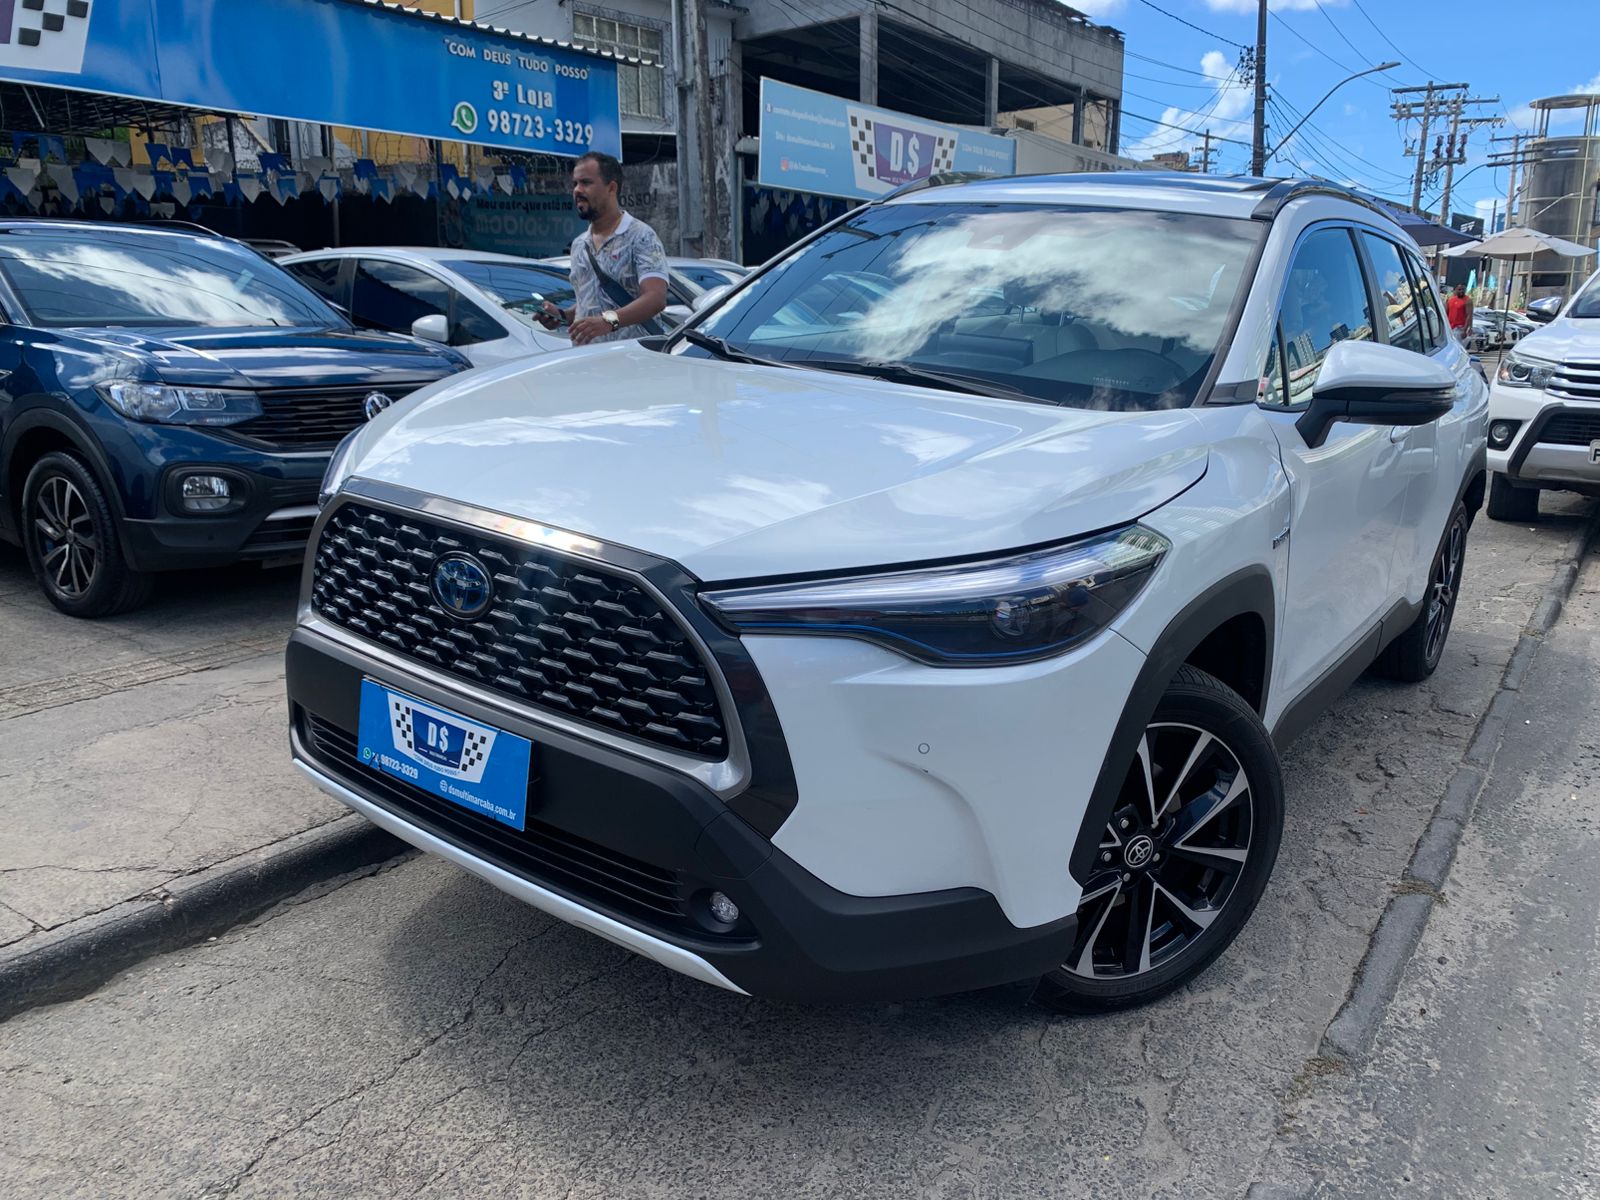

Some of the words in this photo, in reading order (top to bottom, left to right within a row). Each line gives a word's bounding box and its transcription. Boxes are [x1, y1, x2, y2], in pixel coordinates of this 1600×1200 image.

[483, 49, 511, 65] DEUS
[518, 56, 549, 73] TUDO
[517, 83, 553, 109] Loja
[487, 108, 593, 146] 98723-3329
[380, 753, 419, 780] 98723-3329
[447, 784, 517, 821] dsmultimarcaba.com.br
